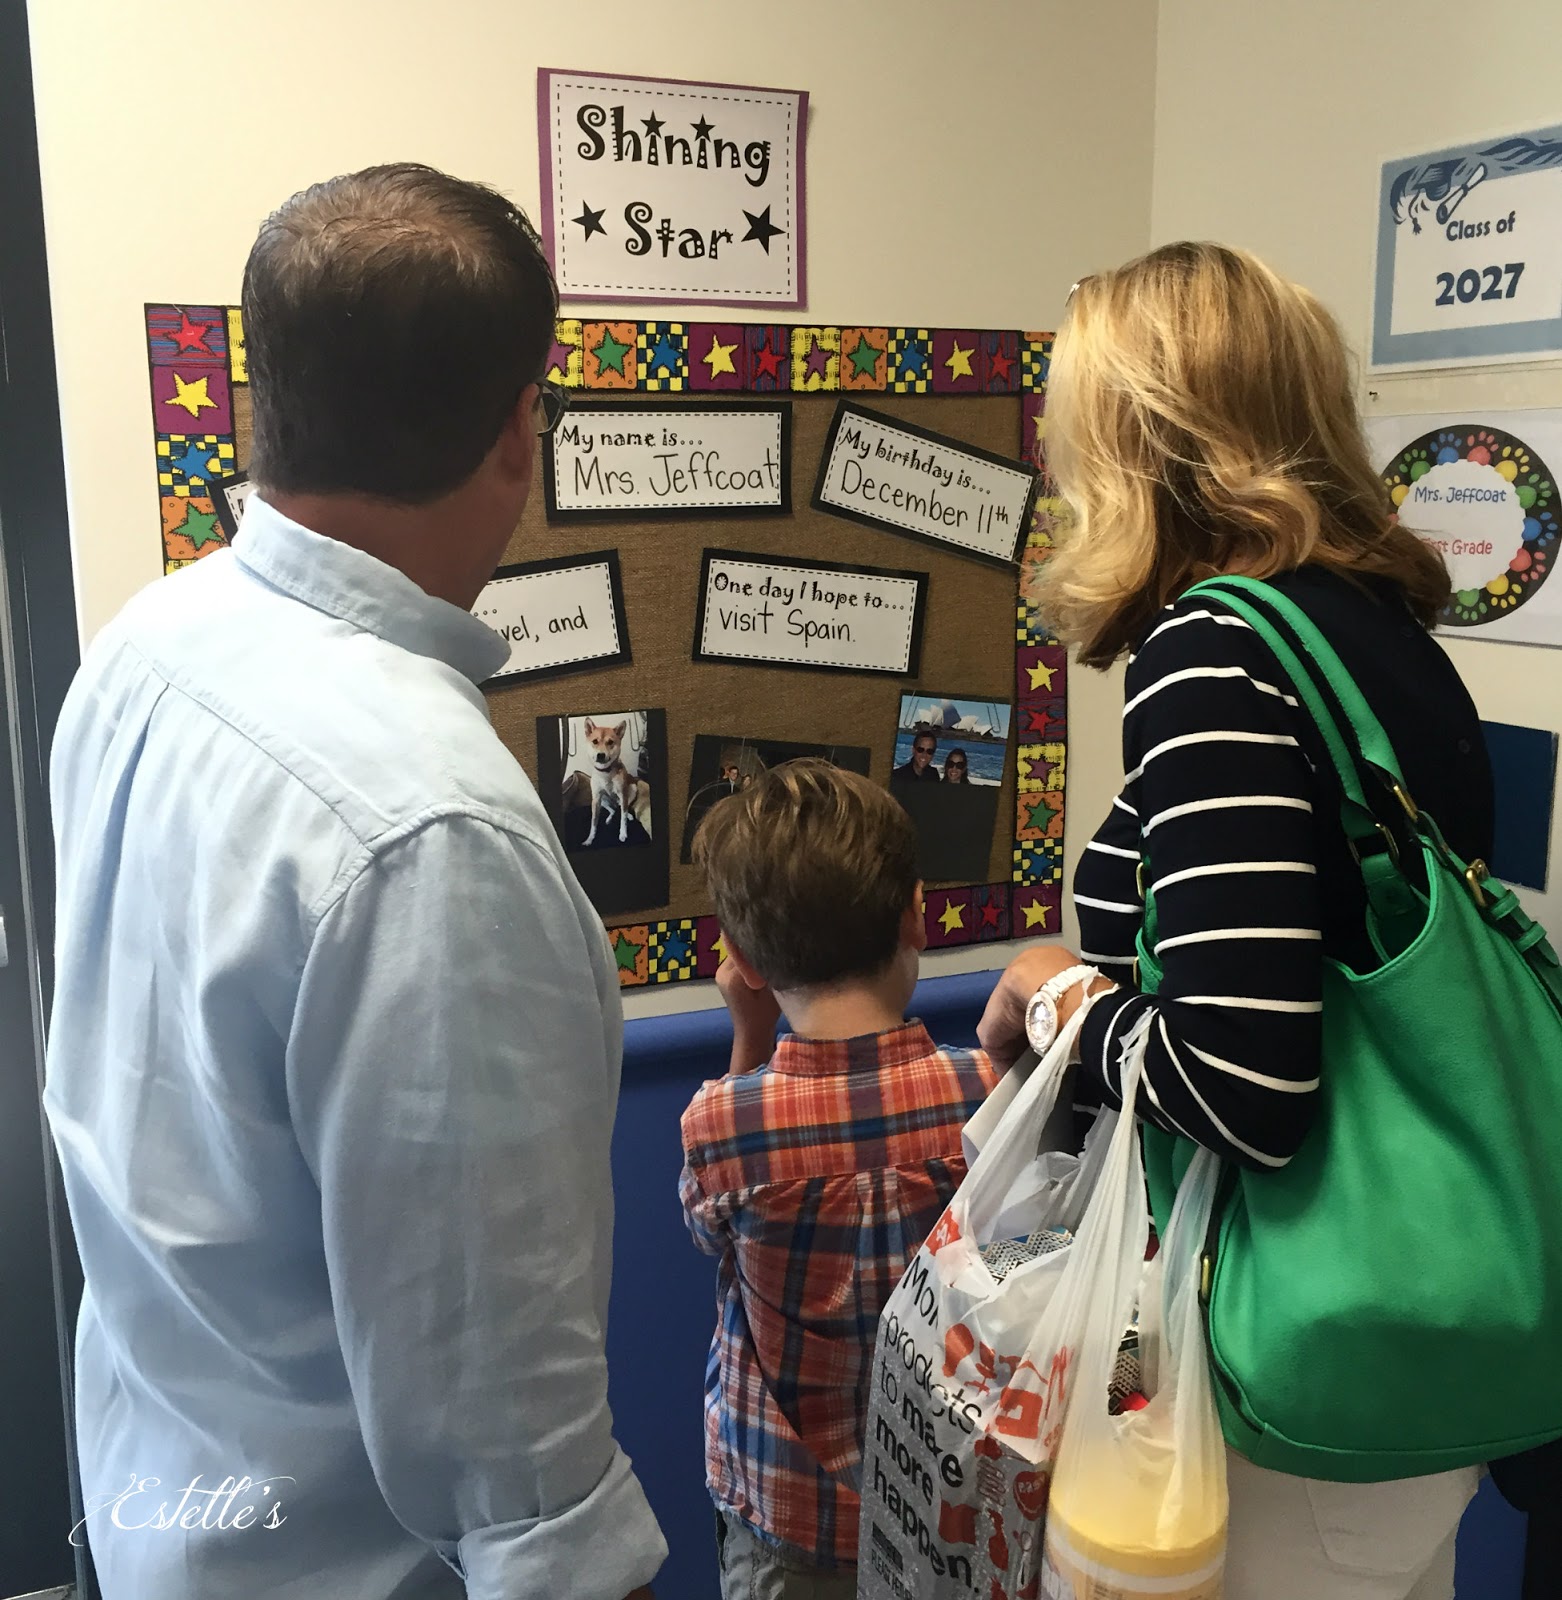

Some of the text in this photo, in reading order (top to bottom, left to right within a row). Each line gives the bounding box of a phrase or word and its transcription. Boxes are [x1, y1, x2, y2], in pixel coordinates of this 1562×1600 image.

[576, 104, 771, 187] Shining
[624, 201, 733, 259] Star
[1446, 210, 1516, 241] Class of
[1435, 262, 1525, 307] 2027
[559, 425, 703, 453] My name is...
[840, 427, 991, 495] My birthday is...
[575, 456, 640, 496] Mrs.
[841, 459, 968, 527] December
[1415, 486, 1507, 504] Mrs. Jeffcoat
[1452, 539, 1493, 555] Grade
[714, 572, 905, 610] One day I hope to...
[494, 605, 589, 643] vel, and
[787, 608, 856, 648] Spain.
[902, 1254, 939, 1330] Mor
[881, 1356, 964, 1488] to mae
[876, 1413, 933, 1507] more
[873, 1454, 979, 1594] happen.
